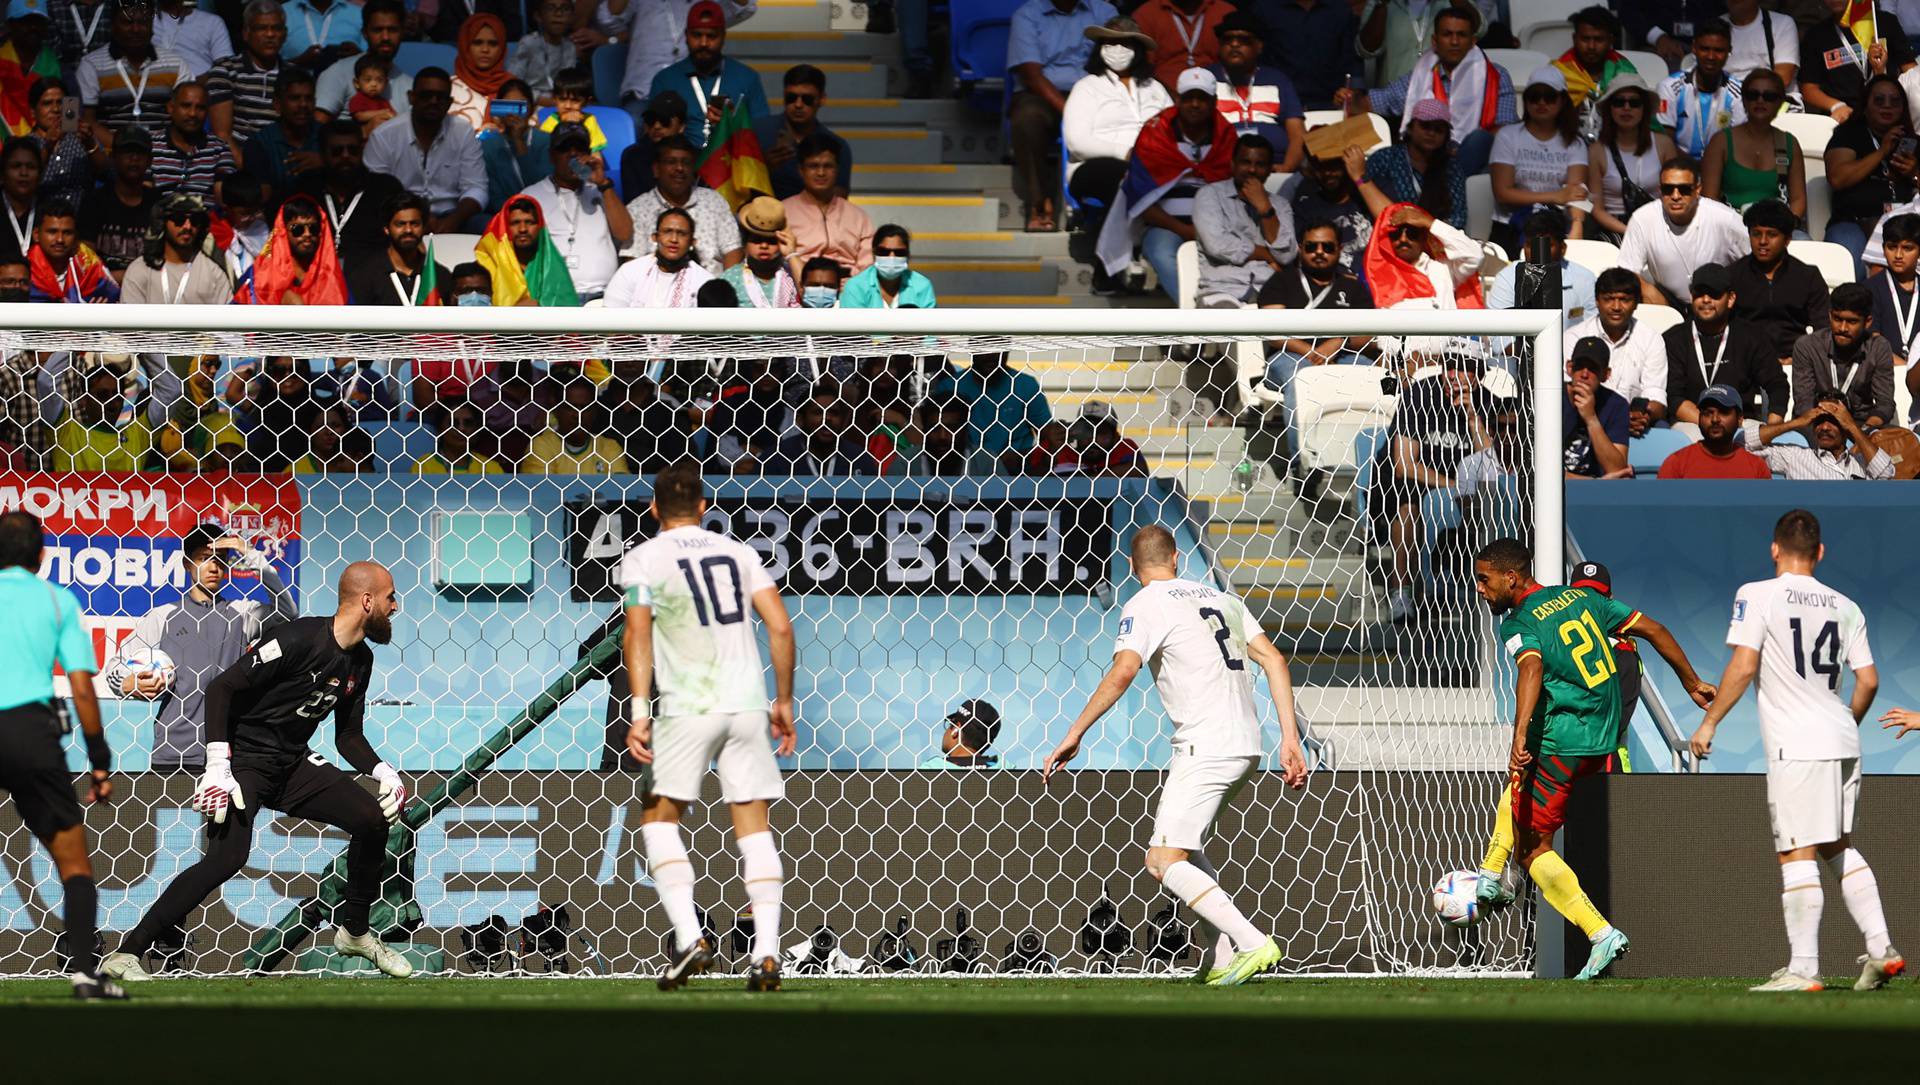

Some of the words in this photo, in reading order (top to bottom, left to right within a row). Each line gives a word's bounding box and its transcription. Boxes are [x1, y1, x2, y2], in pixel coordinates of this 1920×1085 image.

[677, 555, 744, 626] 10
[1199, 606, 1245, 671] 2
[1558, 608, 1618, 690] 21
[1789, 617, 1841, 691] 14
[296, 690, 338, 719] 23
